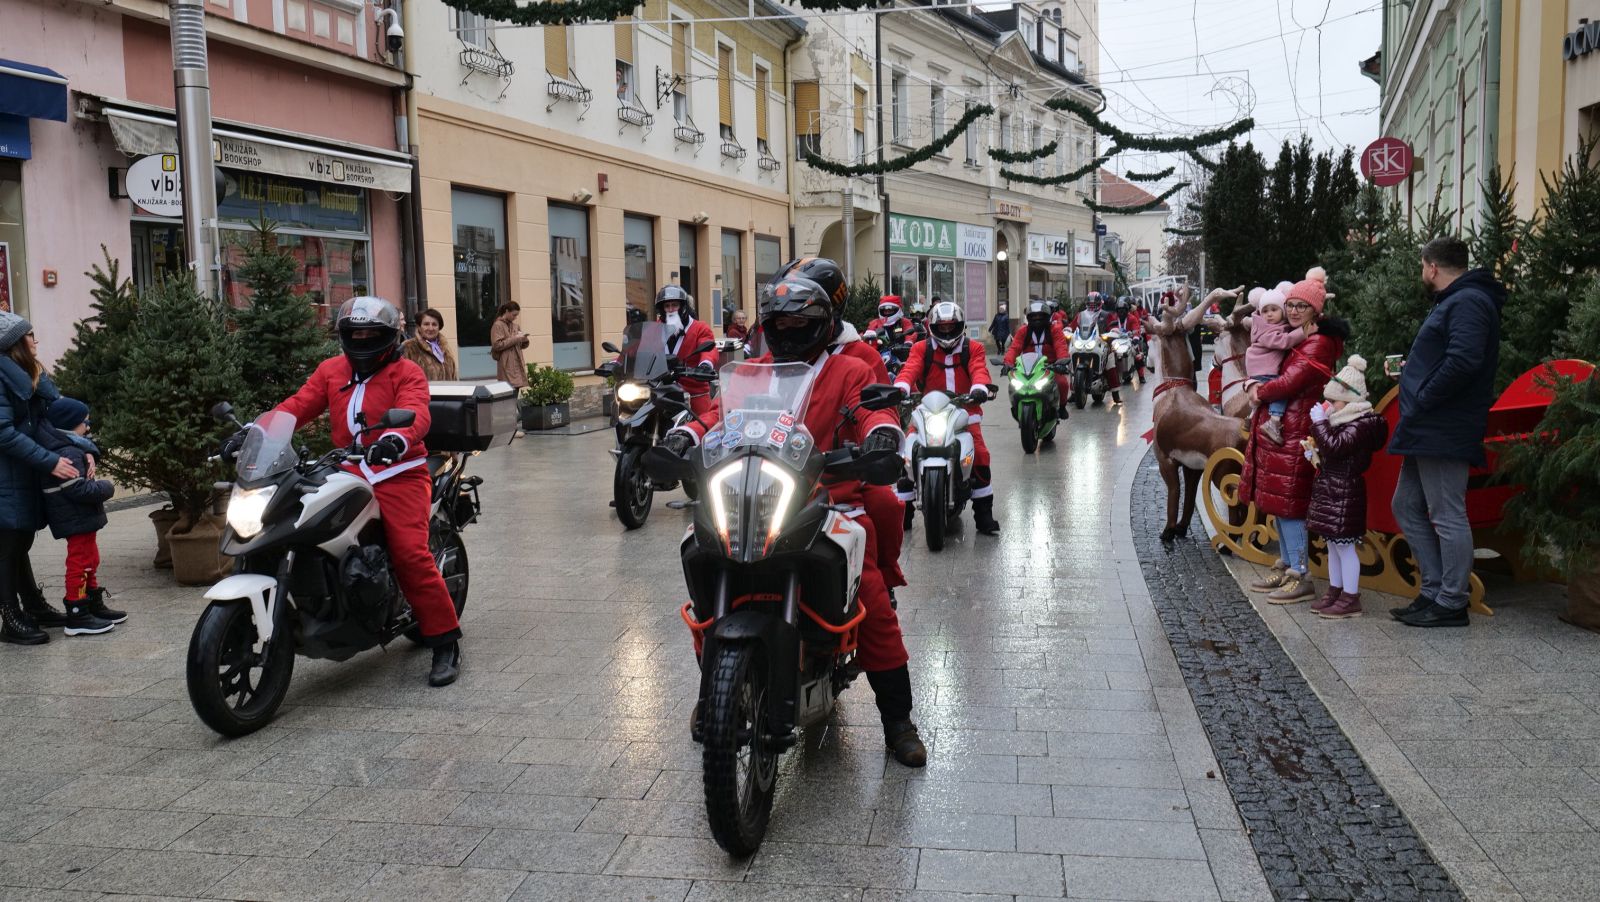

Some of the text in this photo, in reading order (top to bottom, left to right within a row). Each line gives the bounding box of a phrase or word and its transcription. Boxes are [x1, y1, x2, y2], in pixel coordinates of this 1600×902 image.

[223, 142, 258, 156] KNJIŽARA
[224, 153, 262, 167] BOOKSHOP
[345, 163, 372, 175] KNJIŽARA
[346, 173, 375, 185] BOOKSHOP
[137, 197, 167, 205] KNJIŽARA
[890, 216, 952, 251] MODA
[963, 241, 987, 258] LOGOS
